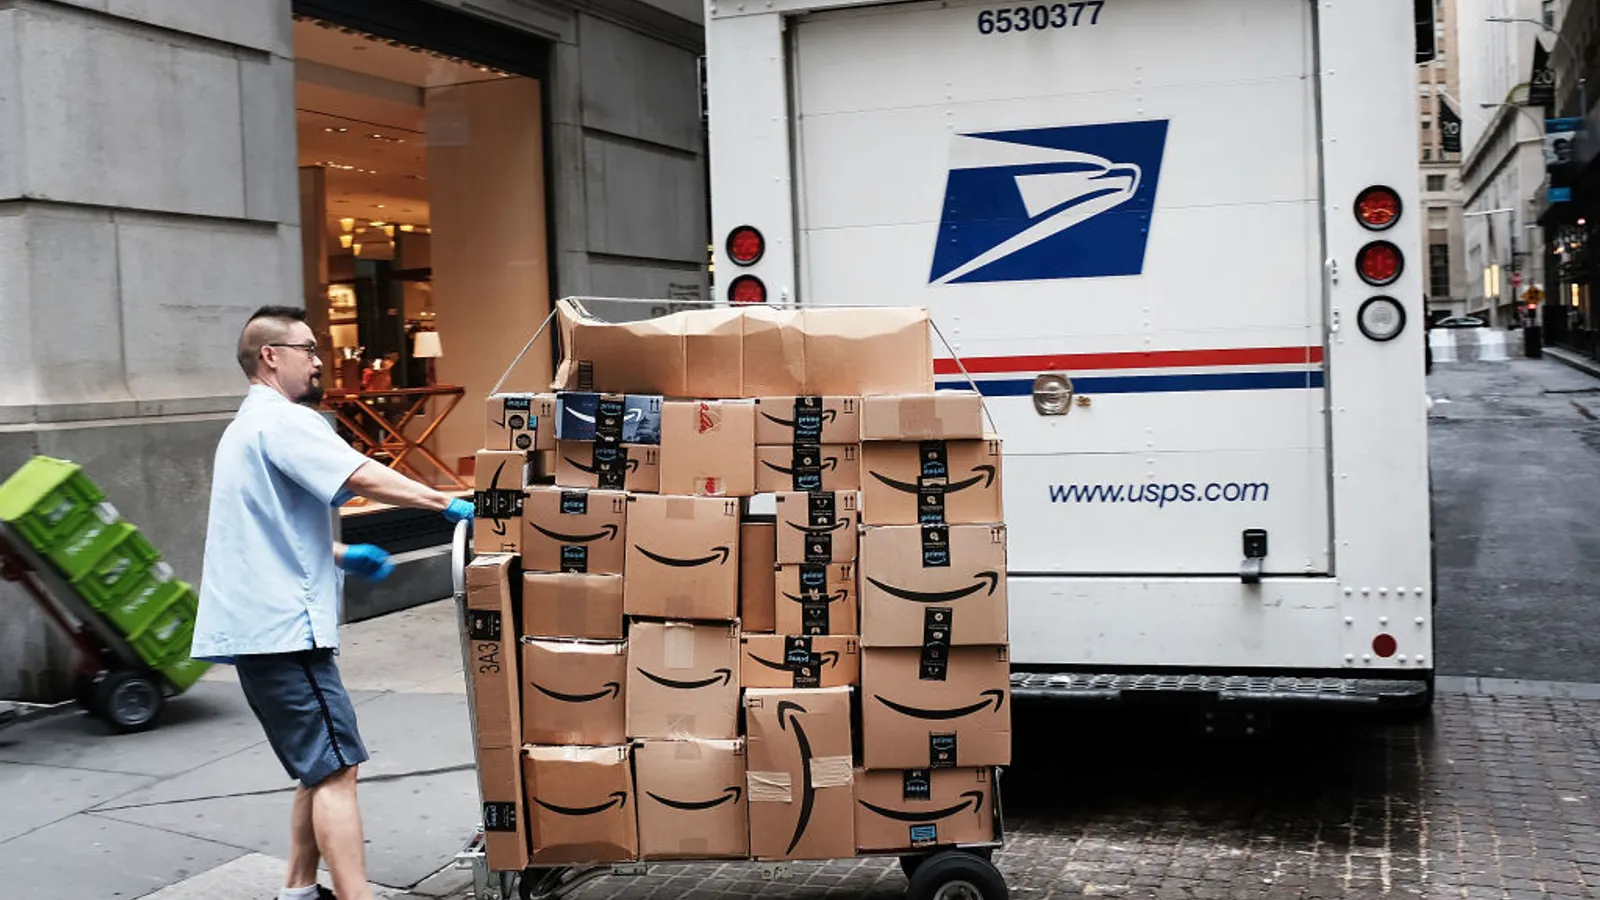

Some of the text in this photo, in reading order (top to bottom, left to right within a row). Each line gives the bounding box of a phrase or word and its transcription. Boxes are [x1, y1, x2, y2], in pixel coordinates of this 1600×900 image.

[978, 1, 1105, 34] 6530377
[1532, 70, 1554, 85] 20
[600, 403, 621, 411] prime
[798, 416, 820, 424] prime
[923, 467, 945, 475] prime
[799, 474, 818, 482] prime
[1049, 482, 1269, 509] www.usps.com
[563, 501, 584, 509] prime
[925, 551, 946, 559] prime
[802, 572, 823, 580] prime
[478, 642, 501, 674] 3A3
[788, 655, 809, 664] prime
[932, 737, 953, 745] prime
[906, 784, 928, 792] prime
[490, 805, 498, 826] prime
